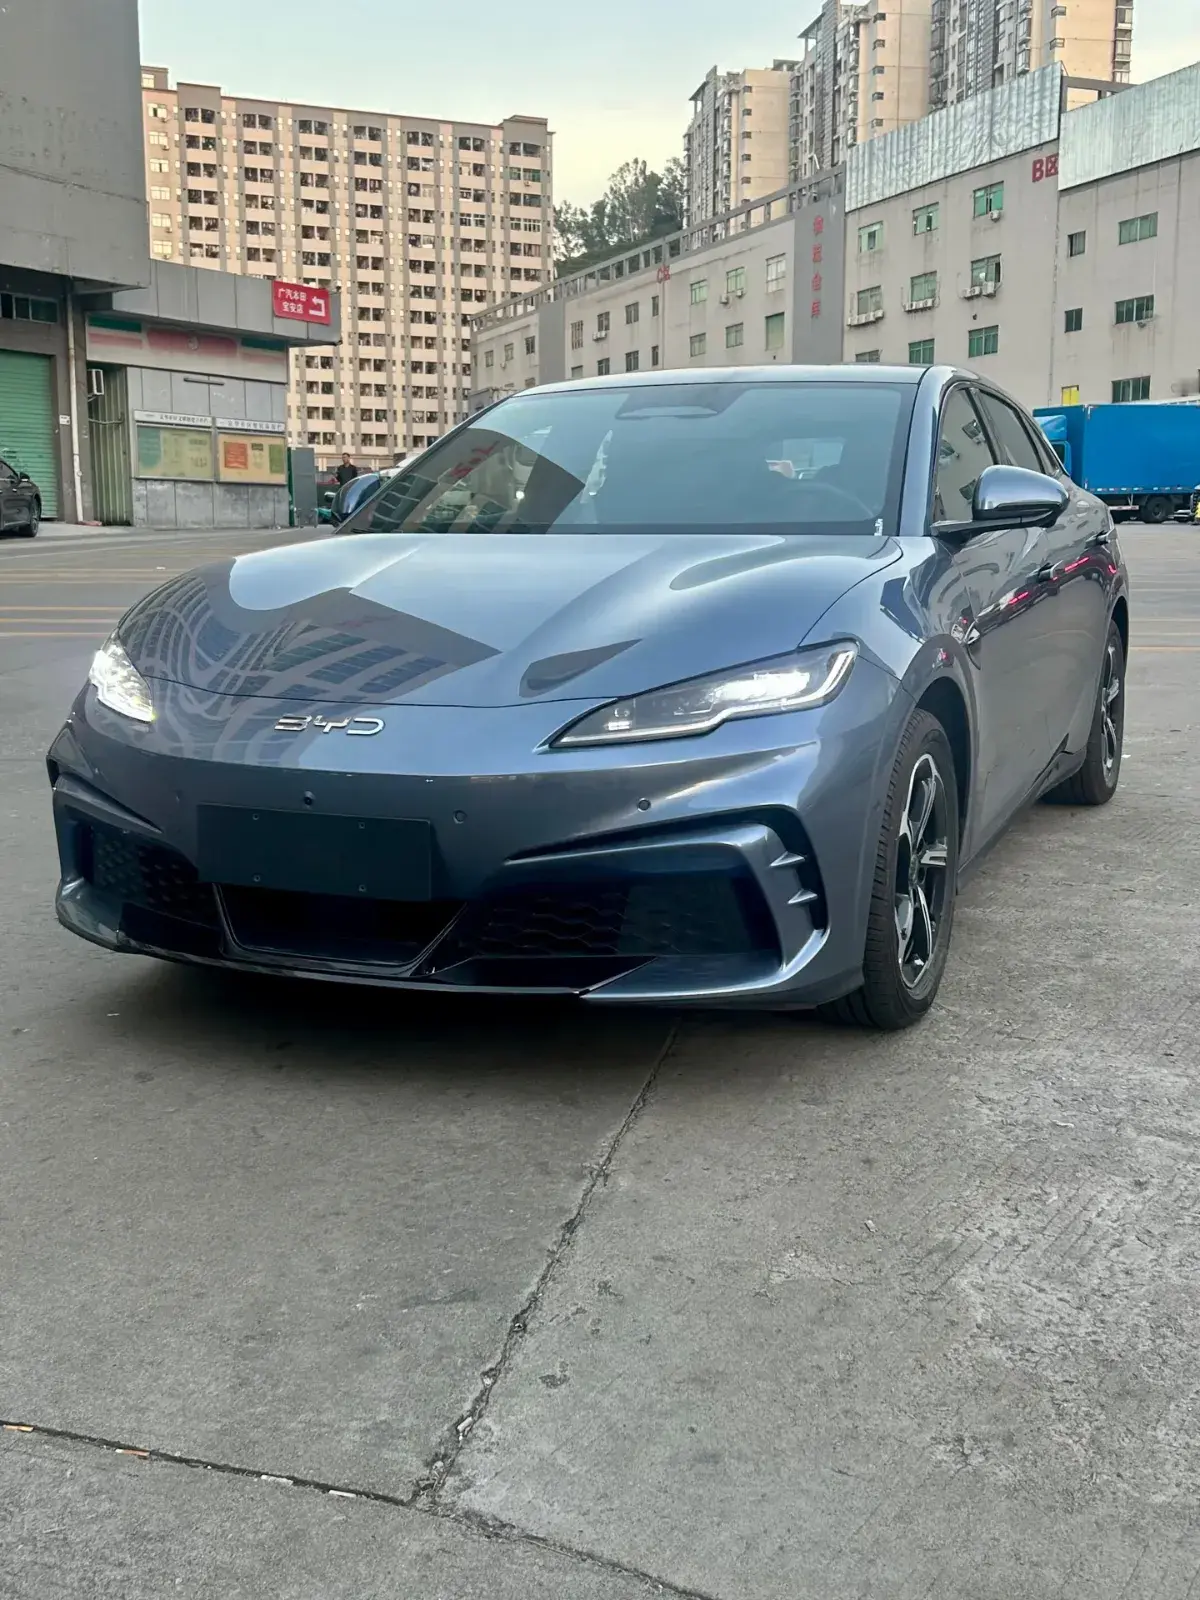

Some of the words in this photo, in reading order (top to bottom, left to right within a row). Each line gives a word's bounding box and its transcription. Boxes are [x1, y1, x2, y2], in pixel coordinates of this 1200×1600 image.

[1032, 153, 1059, 182] B区
[278, 288, 307, 302] 广汽本田
[282, 301, 304, 314] 宝安店
[275, 714, 386, 736] BYD
